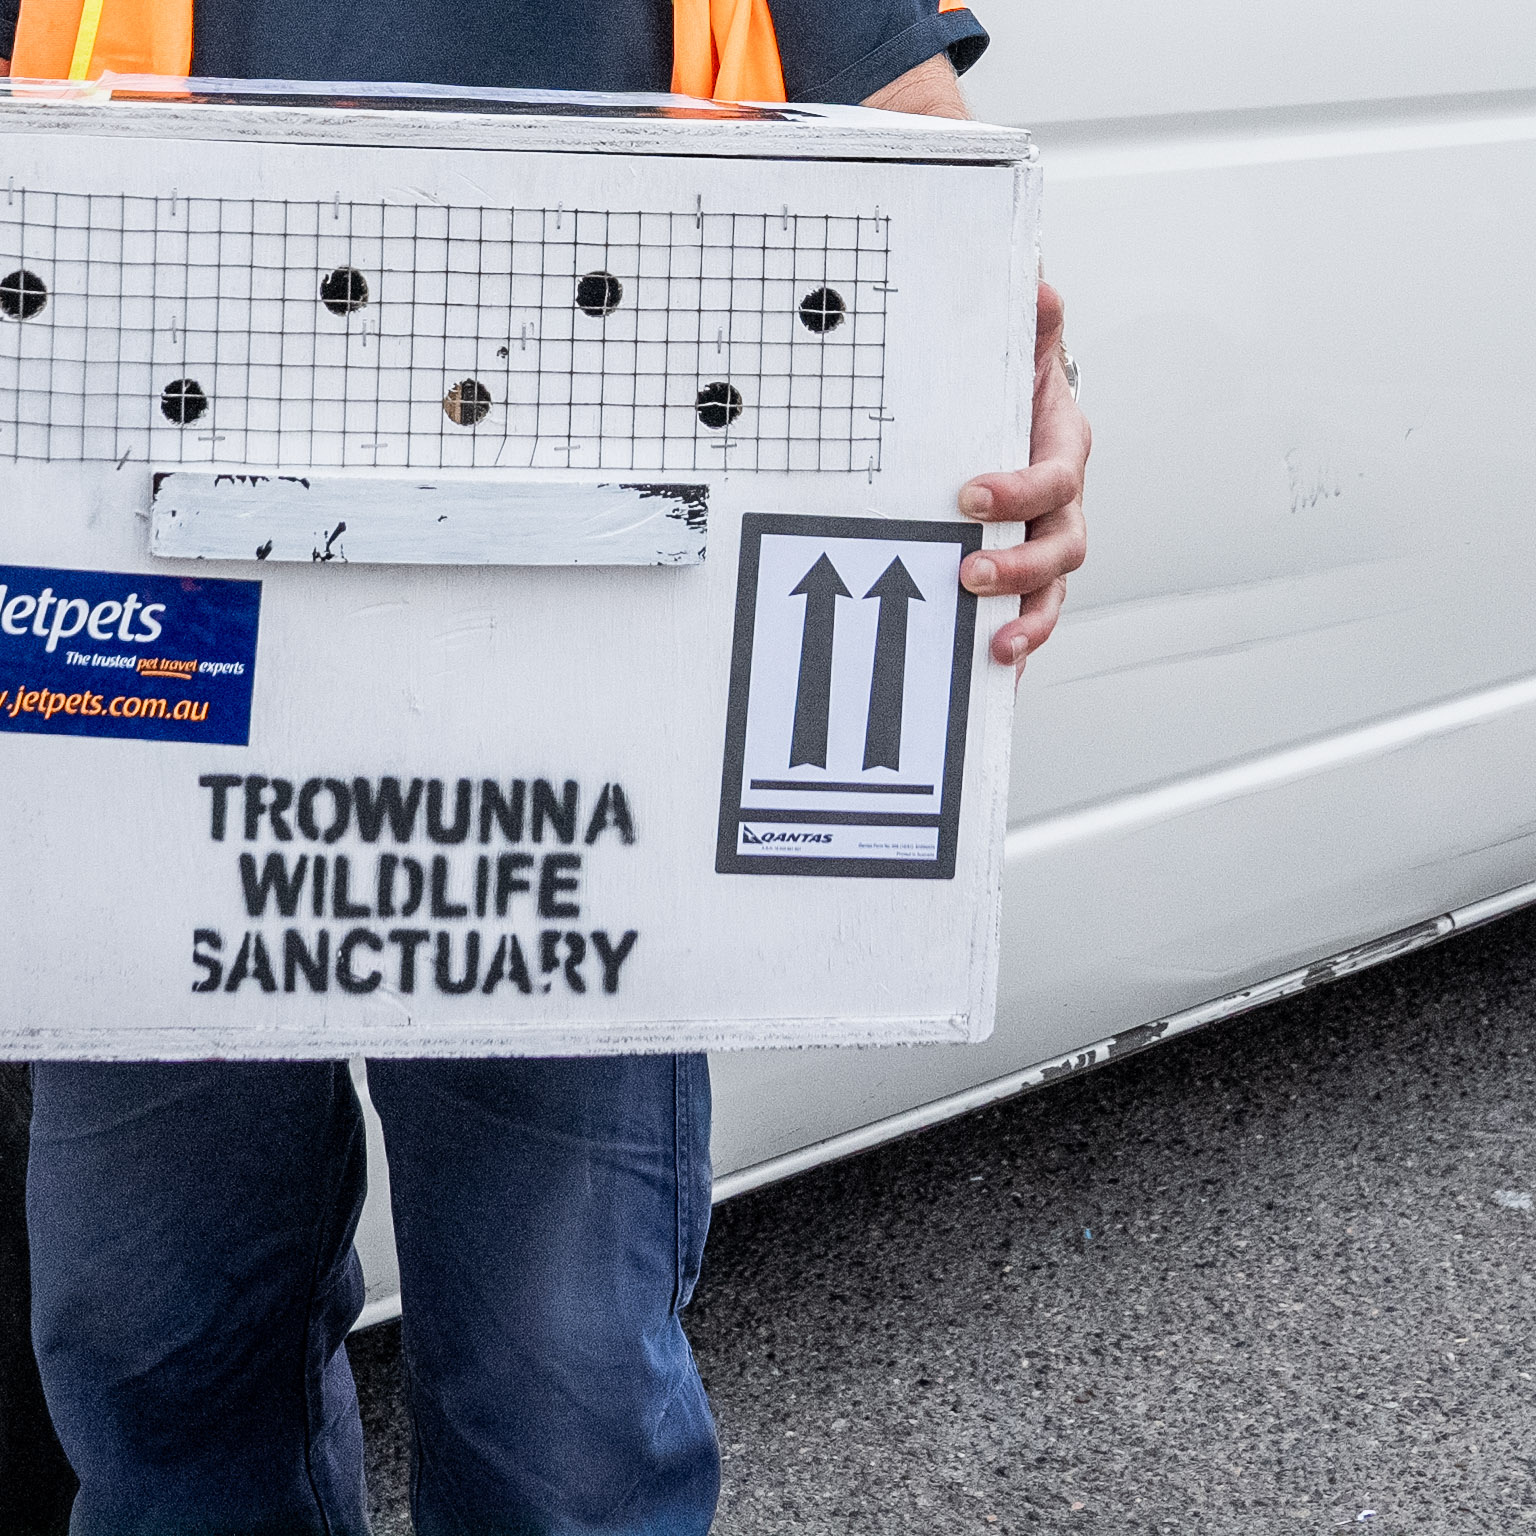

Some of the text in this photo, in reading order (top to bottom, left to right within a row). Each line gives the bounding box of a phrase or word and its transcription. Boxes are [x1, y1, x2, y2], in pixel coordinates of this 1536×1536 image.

[65, 650, 245, 677] The trusted pet travel experts
[199, 772, 637, 847] TROWUNNA
[760, 832, 834, 844] QANTAS
[240, 851, 582, 922] WILDLIFE
[190, 926, 640, 997] SANCTUARY
